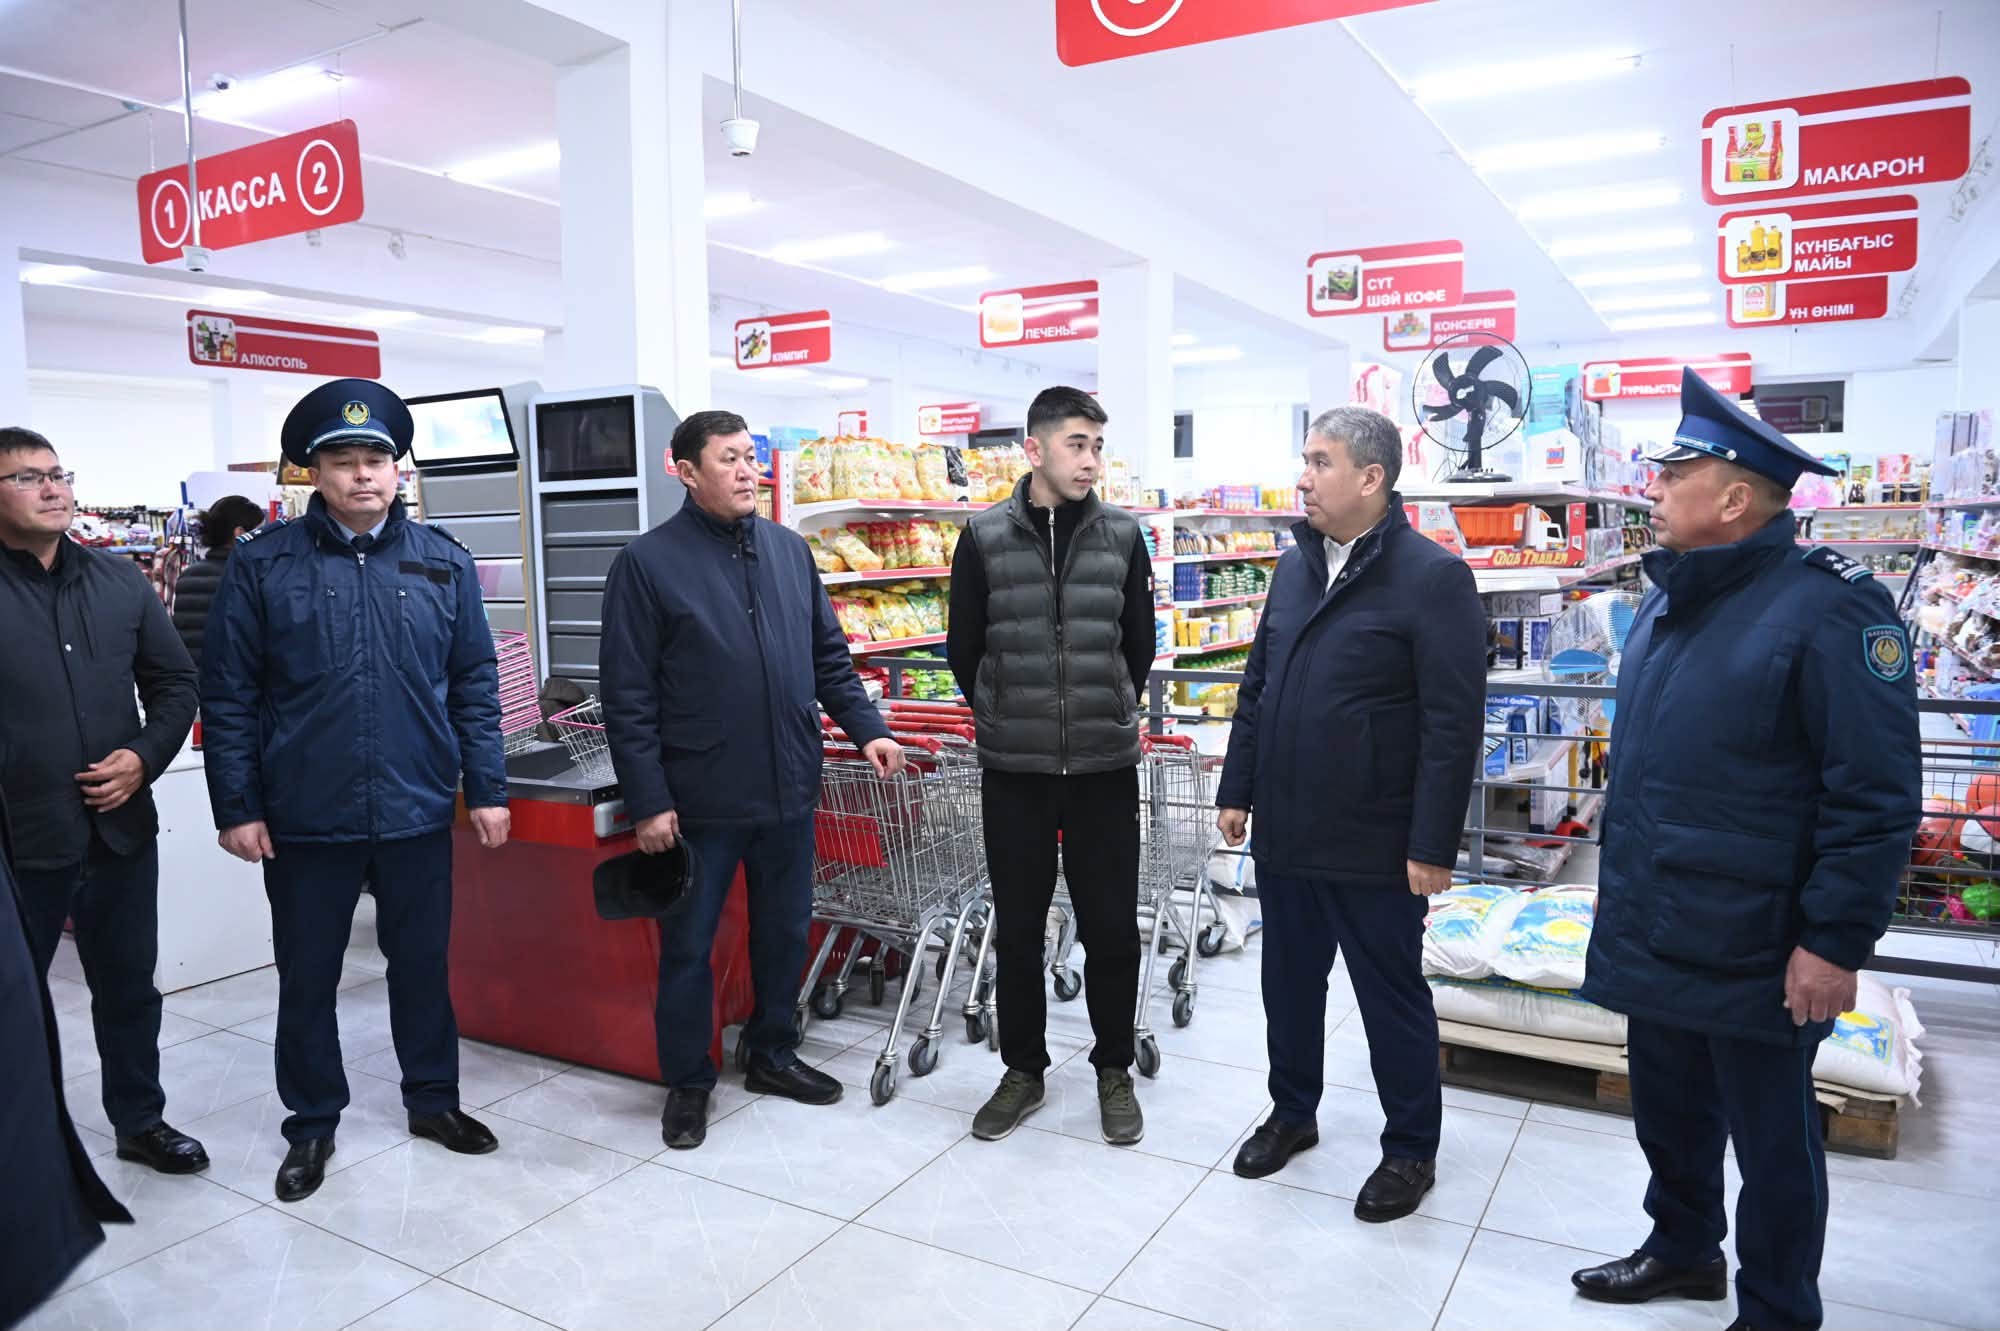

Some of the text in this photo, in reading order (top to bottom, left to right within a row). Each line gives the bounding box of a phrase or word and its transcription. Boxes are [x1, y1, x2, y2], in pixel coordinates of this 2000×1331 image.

[1803, 155, 1925, 187] МАКАРОН
[163, 161, 329, 229] 1 КАССА 2
[1794, 233, 1895, 256] КҮНБАҒЫС
[1793, 254, 1852, 273] МАЙЫ
[1403, 289, 1447, 305] КОФЕ
[1811, 303, 1854, 318] ӨНІМІ
[239, 351, 309, 371] АЛКОГОЛЬ
